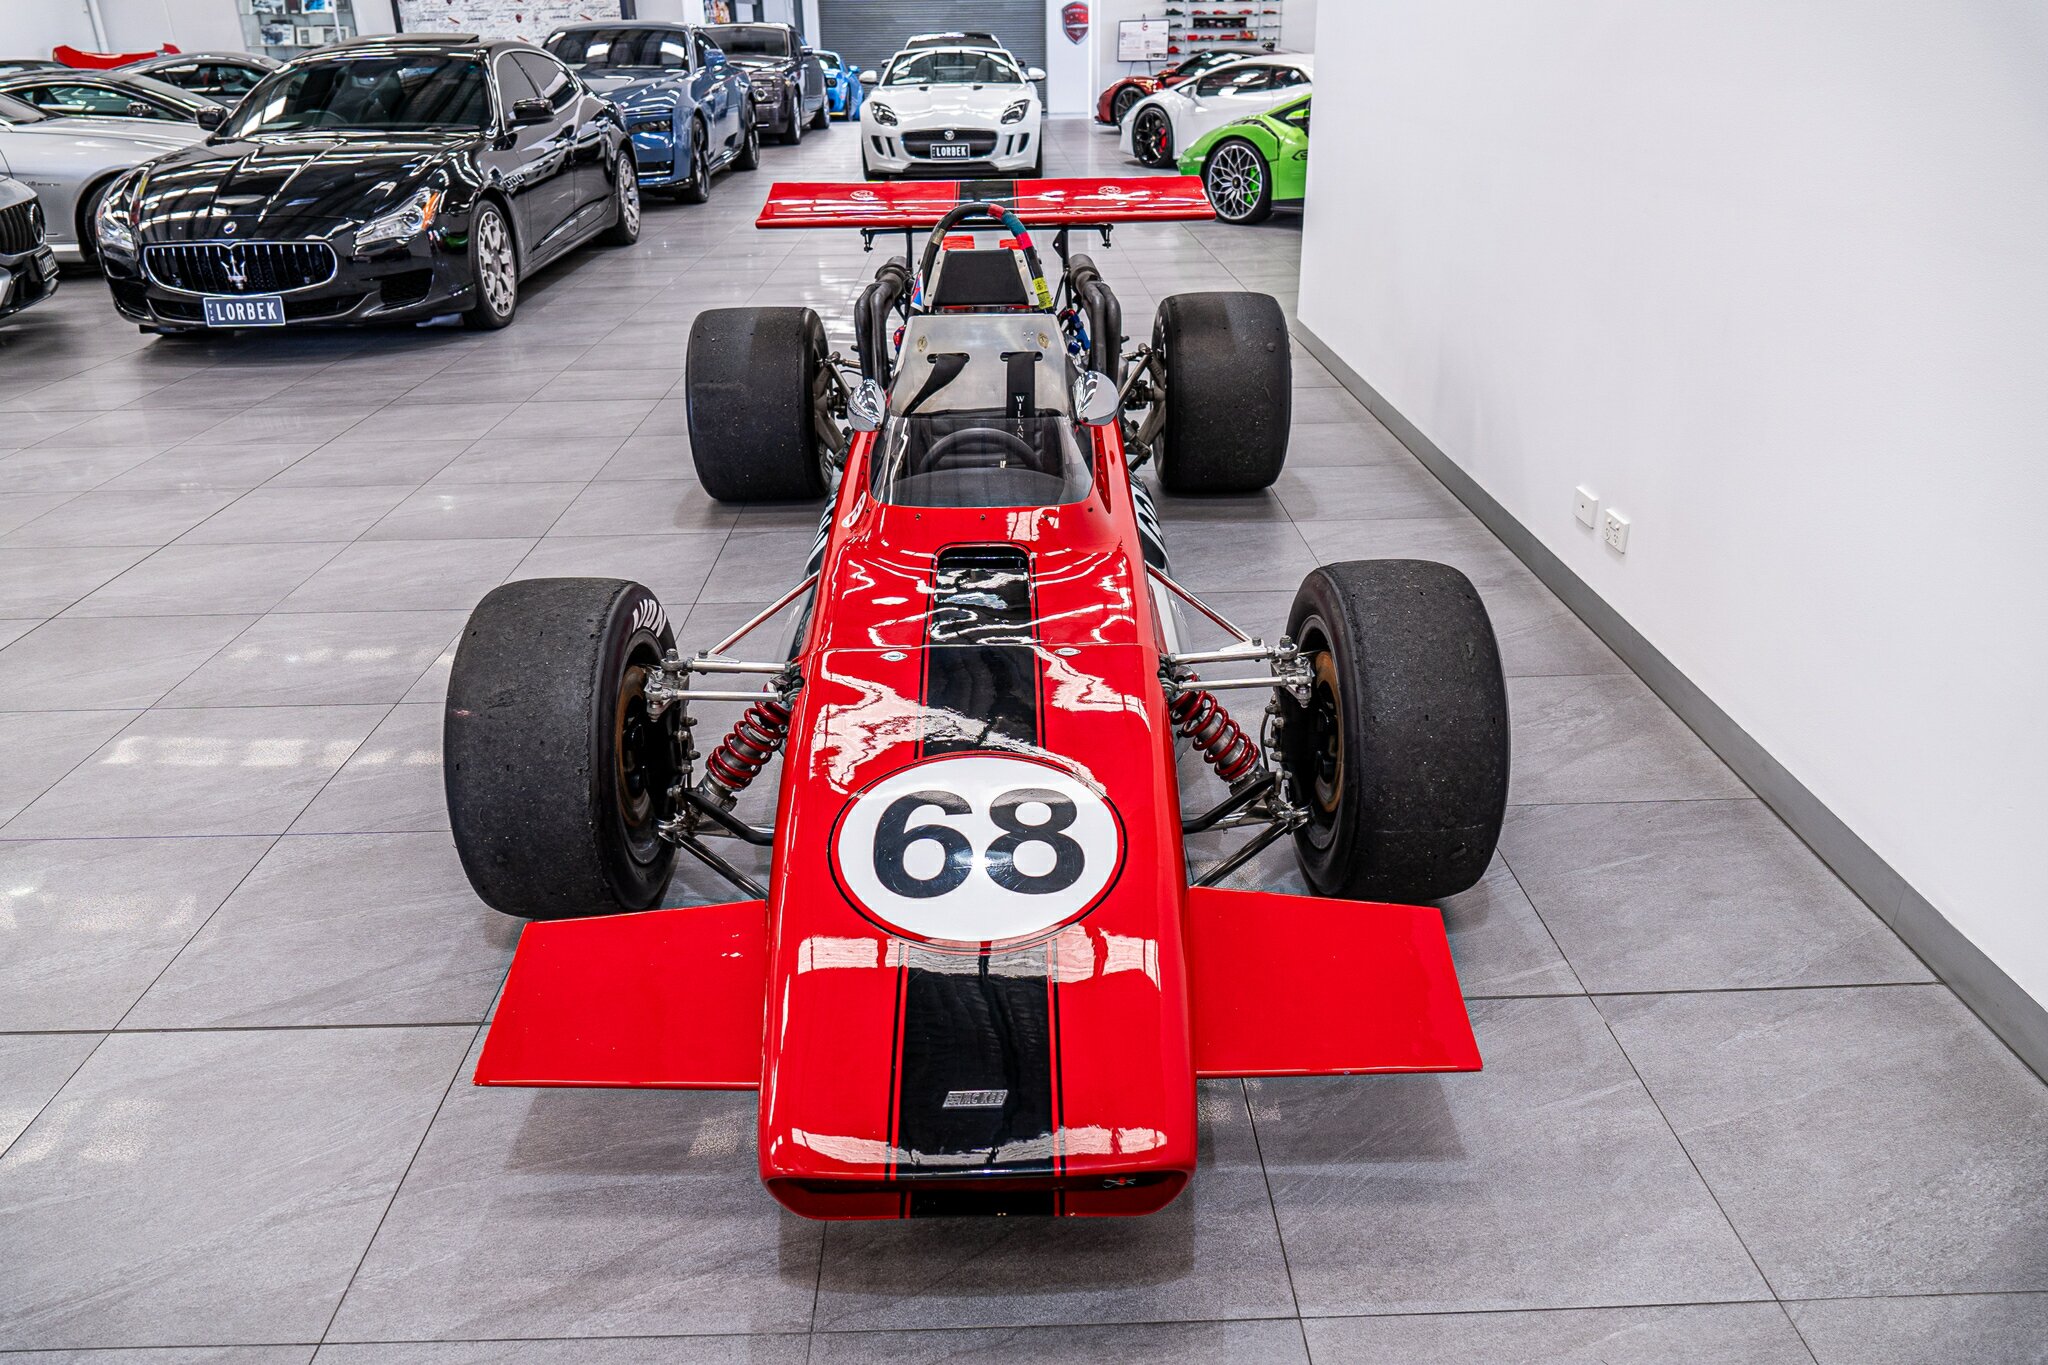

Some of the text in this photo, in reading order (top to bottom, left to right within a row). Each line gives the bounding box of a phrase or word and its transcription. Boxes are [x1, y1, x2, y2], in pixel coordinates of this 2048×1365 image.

[936, 146, 966, 157] LORBEK
[216, 302, 278, 321] LORBEK
[873, 787, 1086, 899] 68
